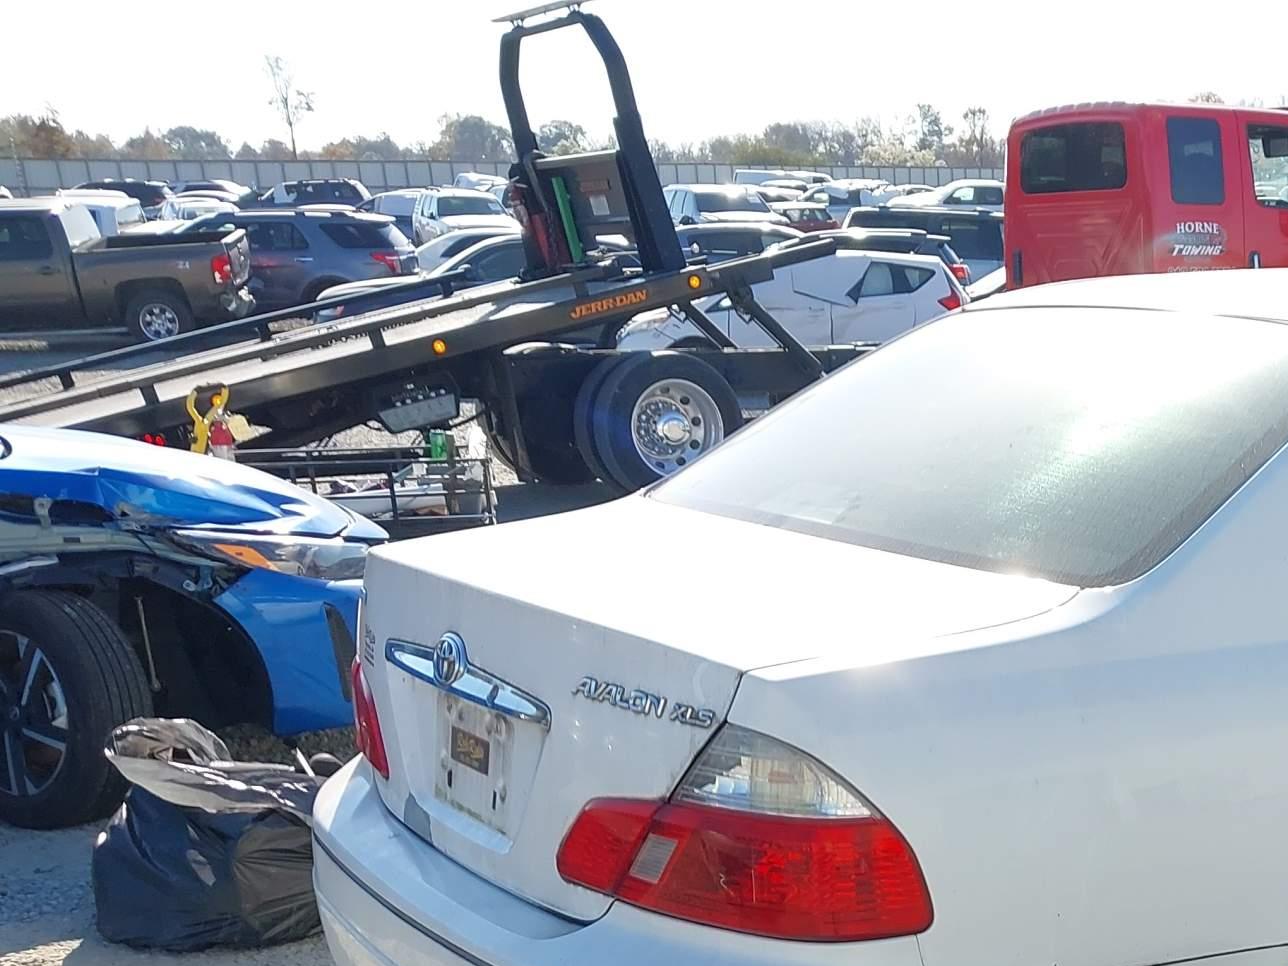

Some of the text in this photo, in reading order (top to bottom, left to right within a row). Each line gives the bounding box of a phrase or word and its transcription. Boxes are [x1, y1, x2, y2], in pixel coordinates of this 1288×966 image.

[1176, 221, 1220, 234] HORNE
[1172, 244, 1223, 257] TOWING
[571, 676, 716, 728] AVALON XLS
